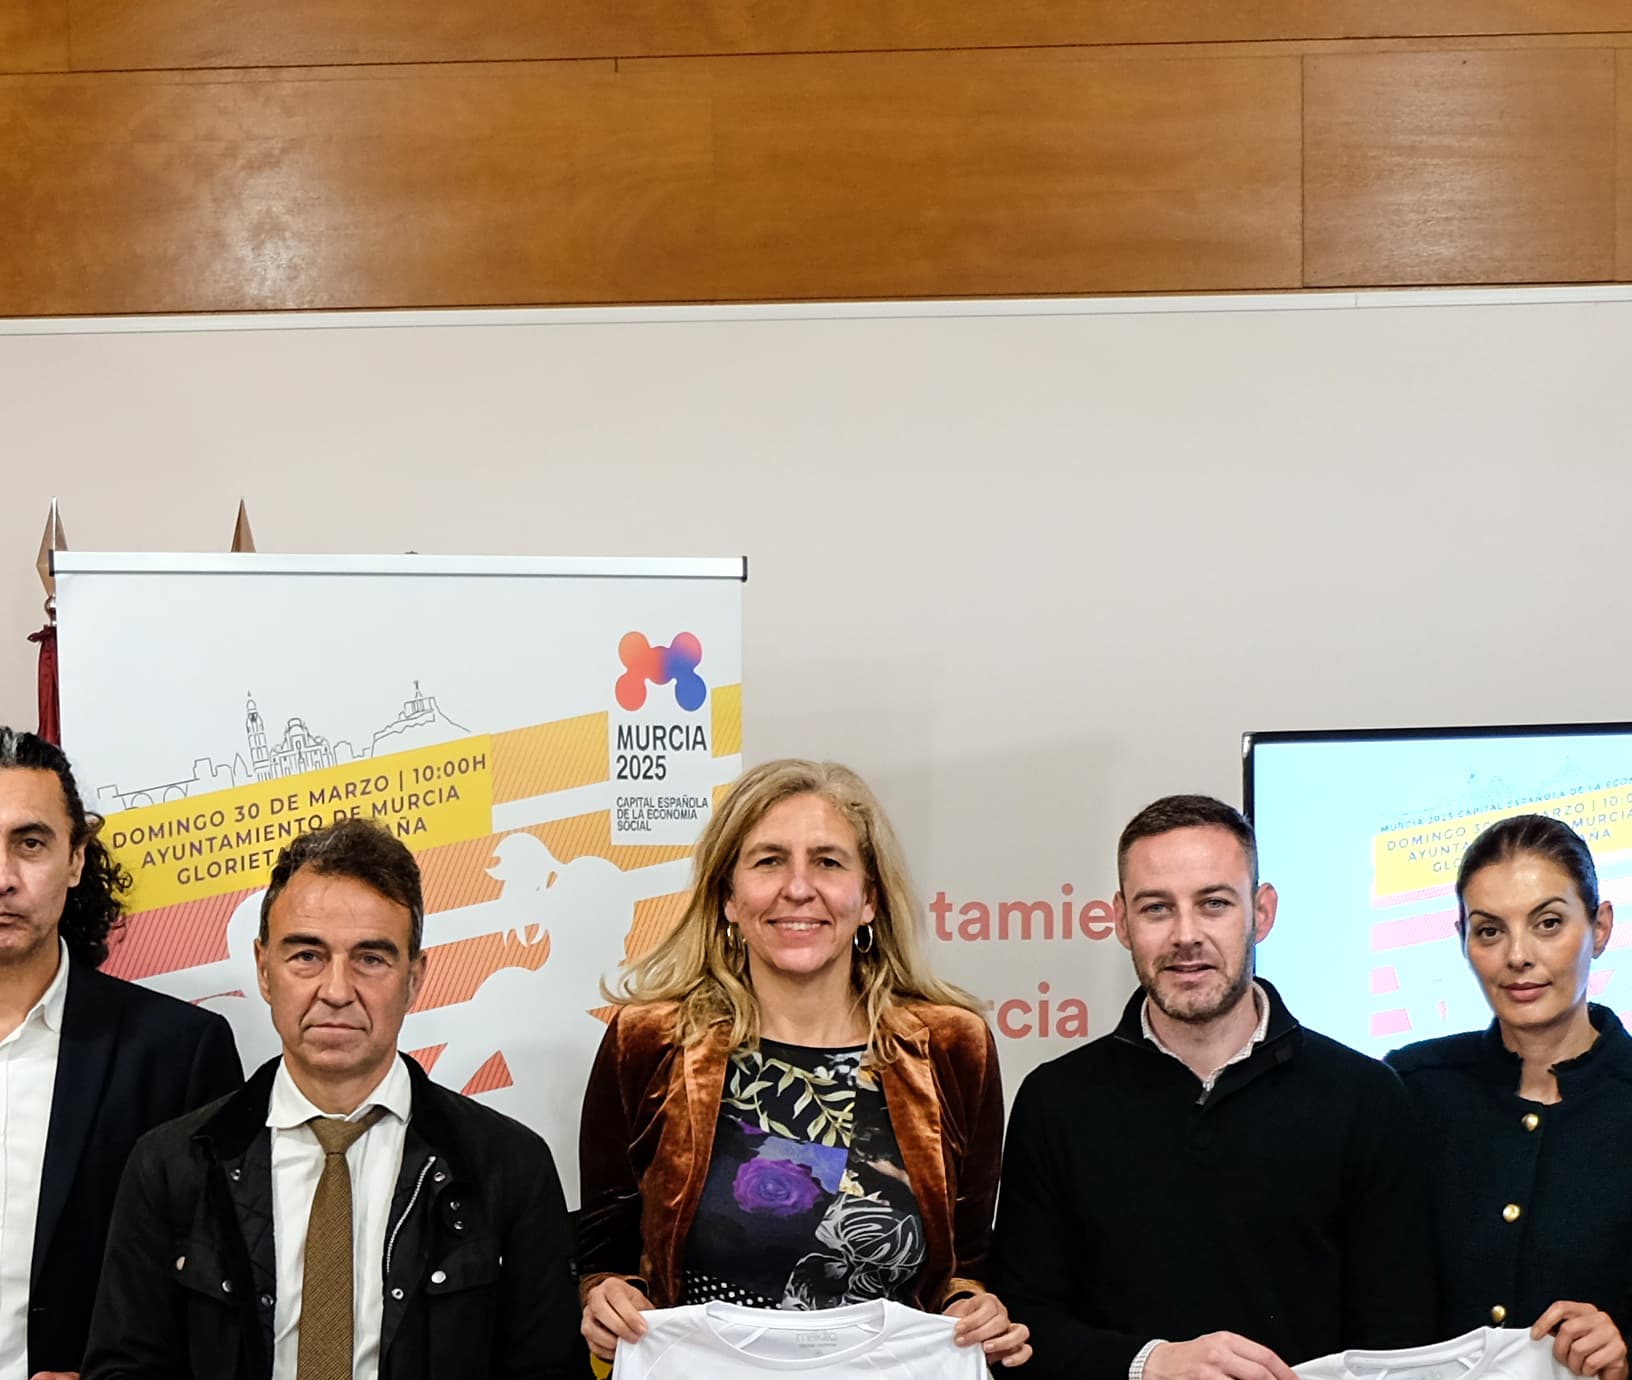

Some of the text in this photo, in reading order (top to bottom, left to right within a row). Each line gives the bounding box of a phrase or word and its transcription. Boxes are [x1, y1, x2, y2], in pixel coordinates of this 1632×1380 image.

[617, 725, 707, 751] MURCIA
[616, 755, 666, 780] 2025
[113, 754, 487, 849] DOMINGO 30 DE MARZO 10:00H
[616, 794, 708, 808] CAPITAL ESPAÑOLA
[617, 809, 628, 819] DE
[632, 809, 644, 819] LA
[141, 815, 323, 868] AYUNTAMIENTO
[371, 785, 460, 819] MURCIA
[617, 820, 651, 831] SOCIAL
[1386, 825, 1467, 851] DOMINGO
[177, 850, 274, 885] GLORIET
[930, 883, 1115, 941] tamie
[992, 981, 1088, 1039] cia
